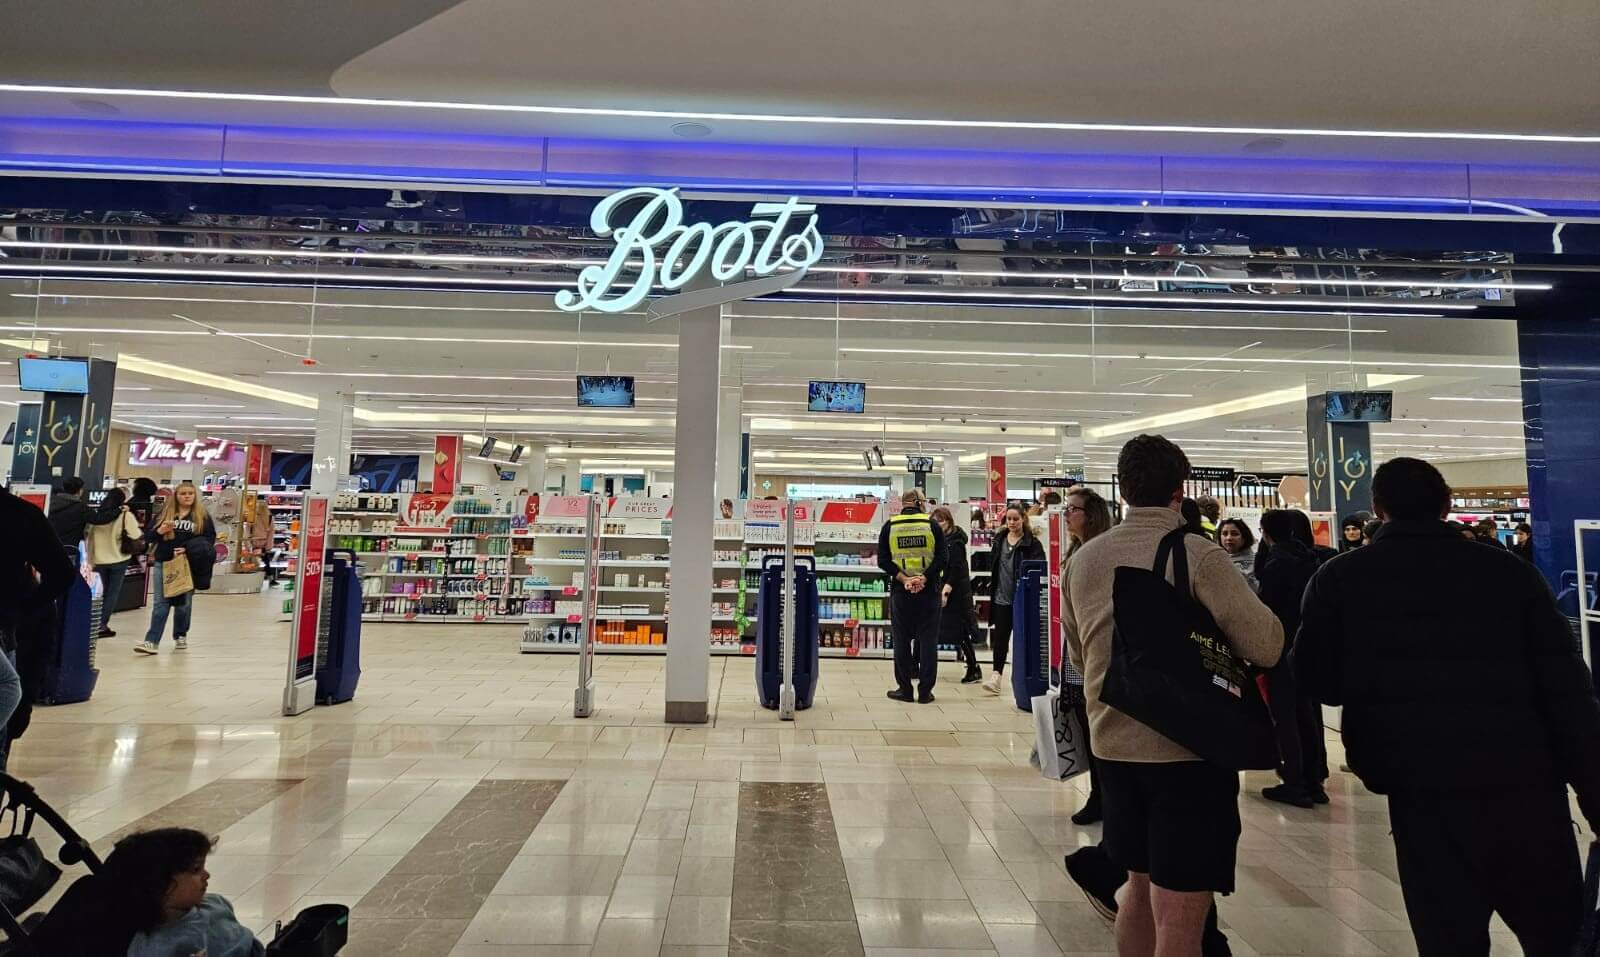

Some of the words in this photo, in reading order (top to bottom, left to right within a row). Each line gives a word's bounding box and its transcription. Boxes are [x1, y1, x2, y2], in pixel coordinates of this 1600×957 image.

[555, 187, 824, 313] Boots
[139, 437, 180, 460] Mix
[181, 439, 205, 463] it
[430, 501, 437, 511] 2
[900, 536, 925, 547] SECURITY
[305, 561, 321, 577] 50%
[1190, 632, 1213, 649] AIMÉ
